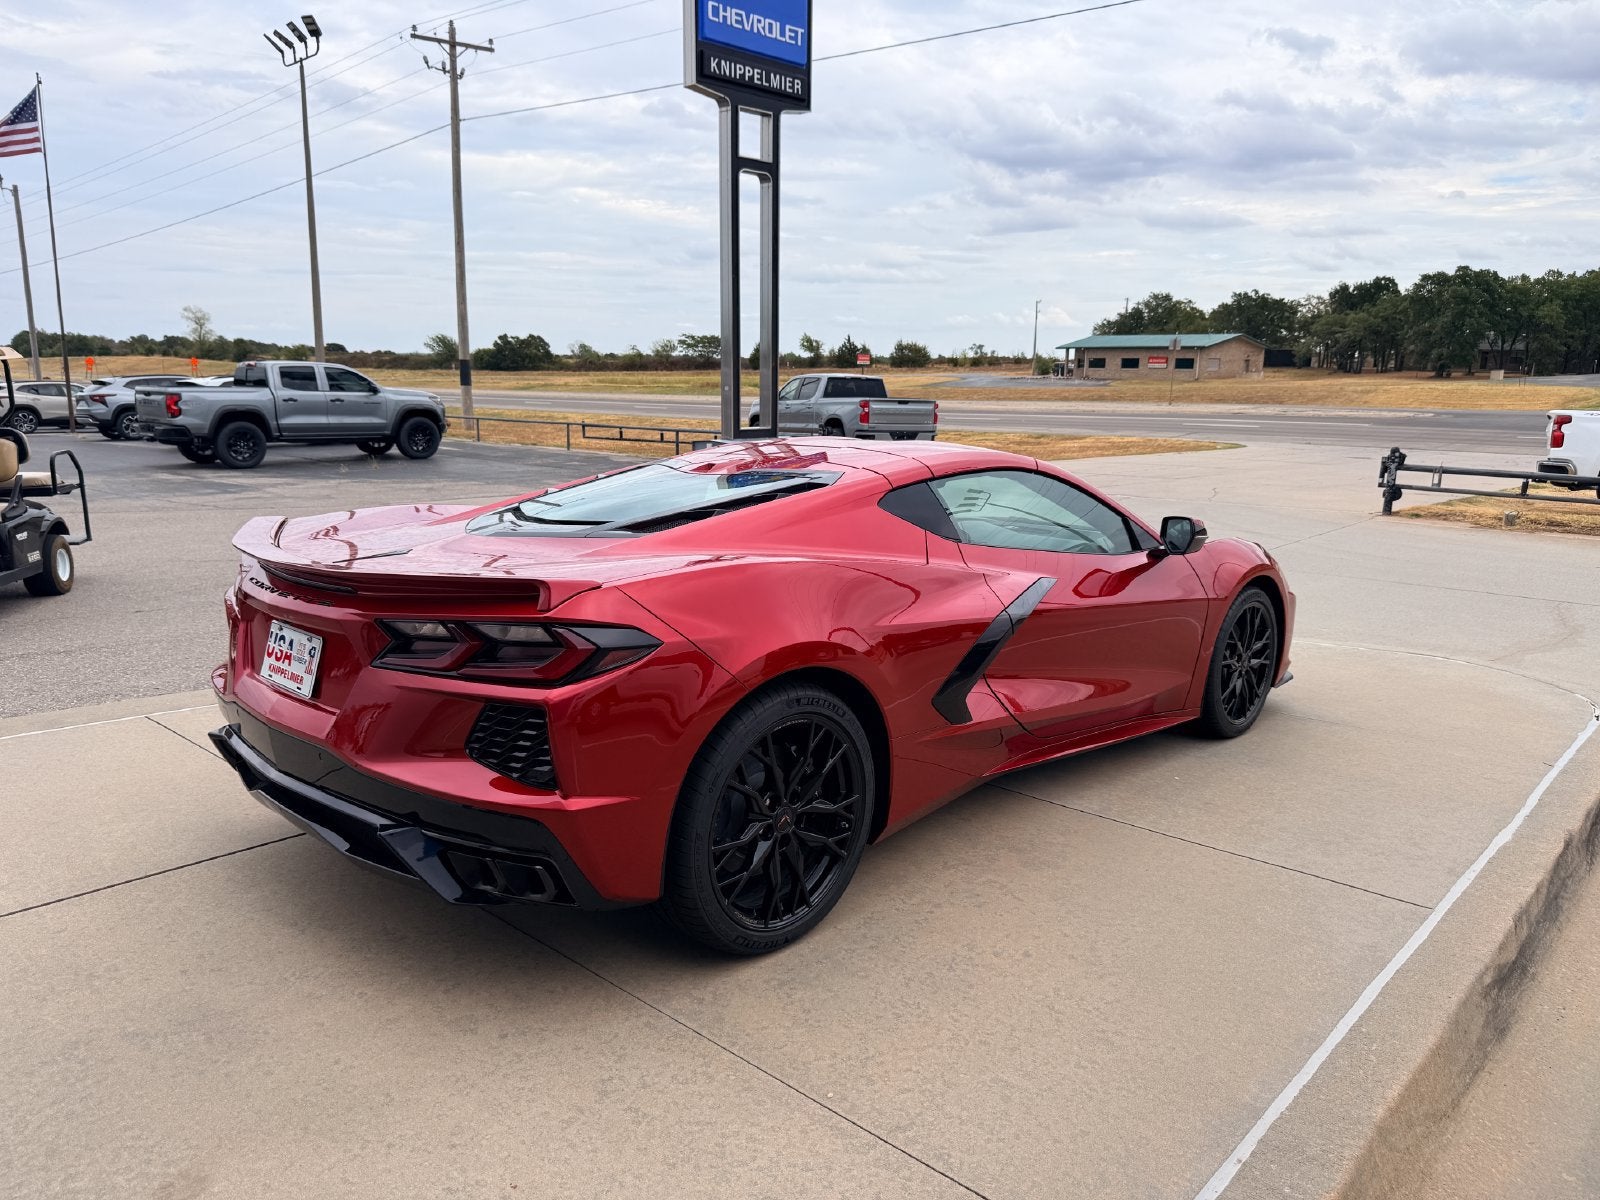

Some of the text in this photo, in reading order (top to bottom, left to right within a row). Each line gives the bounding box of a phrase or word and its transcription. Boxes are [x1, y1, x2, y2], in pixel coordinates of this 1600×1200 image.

[707, 1, 804, 46] CHEVROLET
[710, 56, 802, 95] KNIPPELMIER
[266, 631, 294, 666] USA
[268, 663, 304, 685] KNIPPELMIER
[799, 697, 846, 717] MICHELIN
